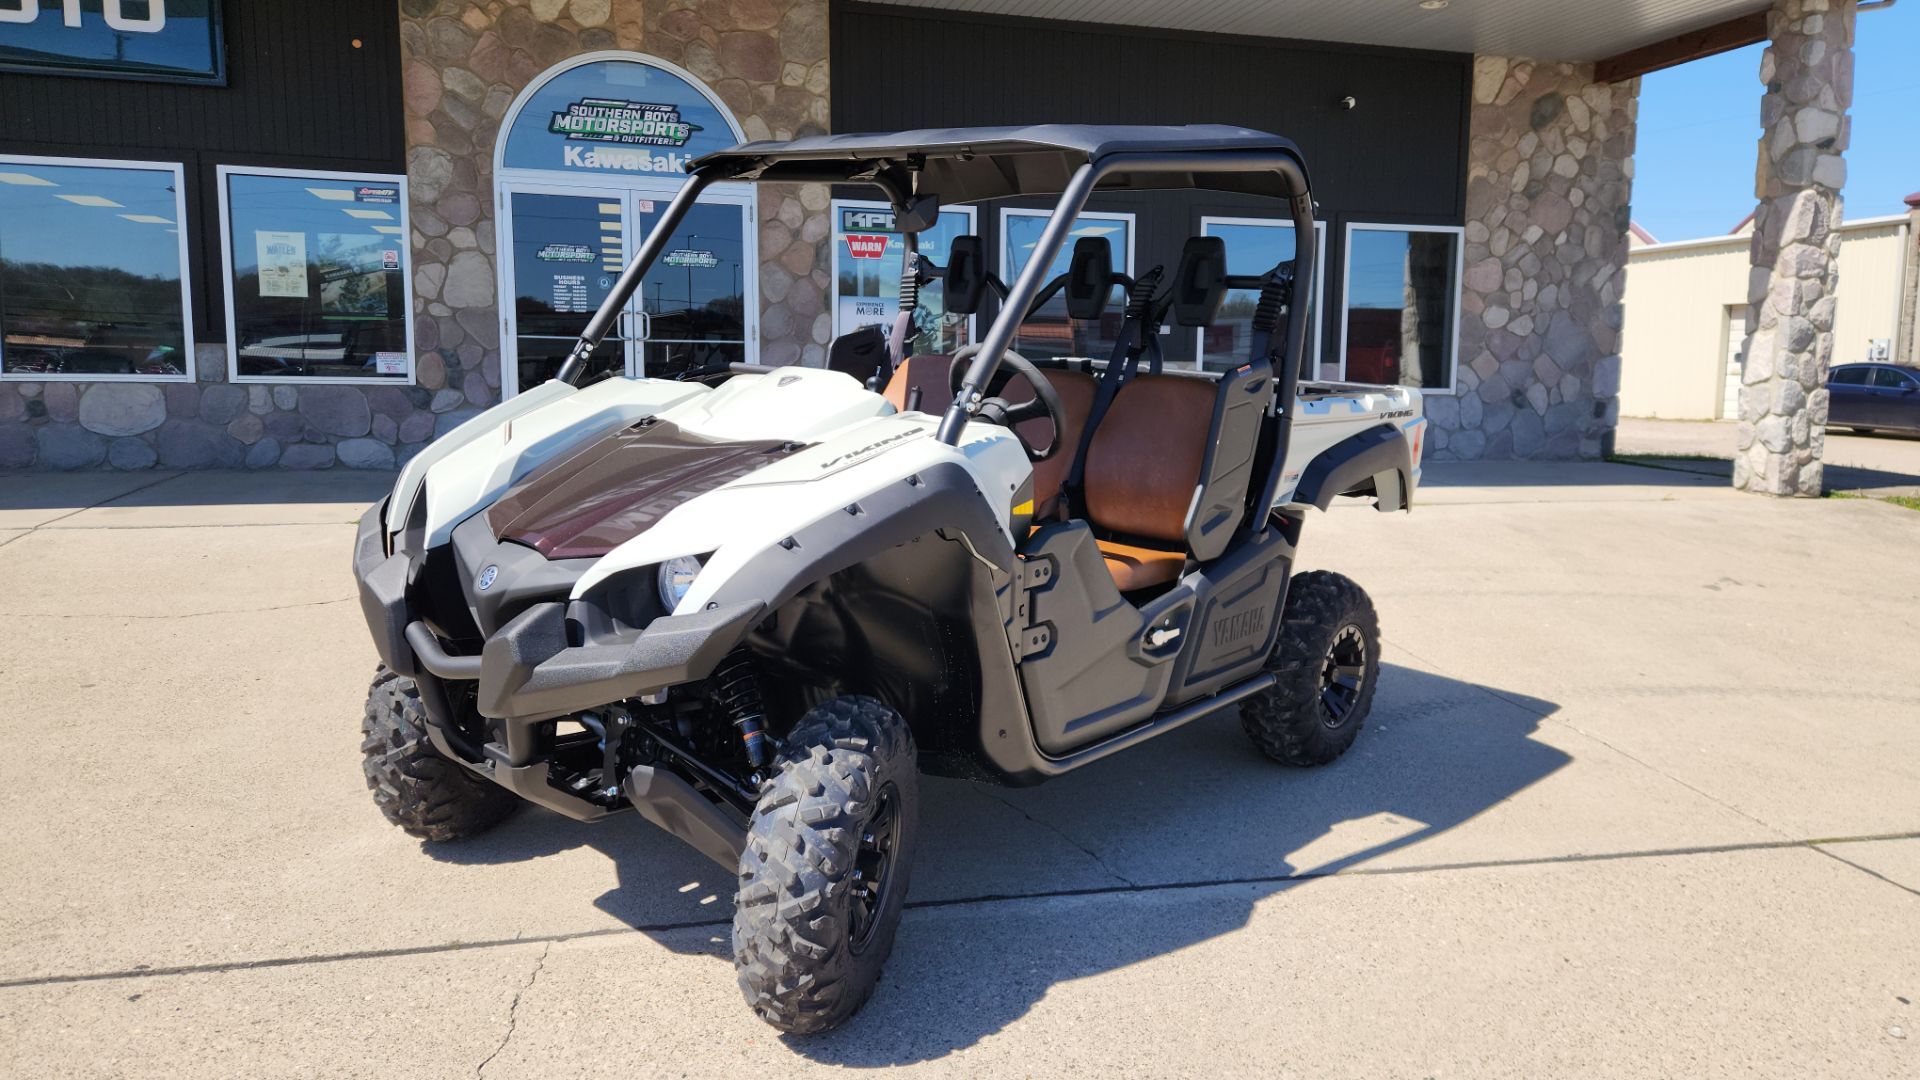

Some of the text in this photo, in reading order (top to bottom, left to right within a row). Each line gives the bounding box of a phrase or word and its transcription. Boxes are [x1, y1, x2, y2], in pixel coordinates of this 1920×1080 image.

[570, 105, 679, 123] SOUTHERN BOYS
[553, 114, 690, 138] MOTORSPORTS
[621, 136, 675, 146] OUTFITTERS
[563, 145, 692, 174] Kawasaki
[851, 241, 882, 252] WARN
[887, 240, 935, 250] Kawaki
[1379, 410, 1414, 419] VIKING
[821, 427, 925, 469] VIKING
[1213, 606, 1265, 648] YAMAHA
